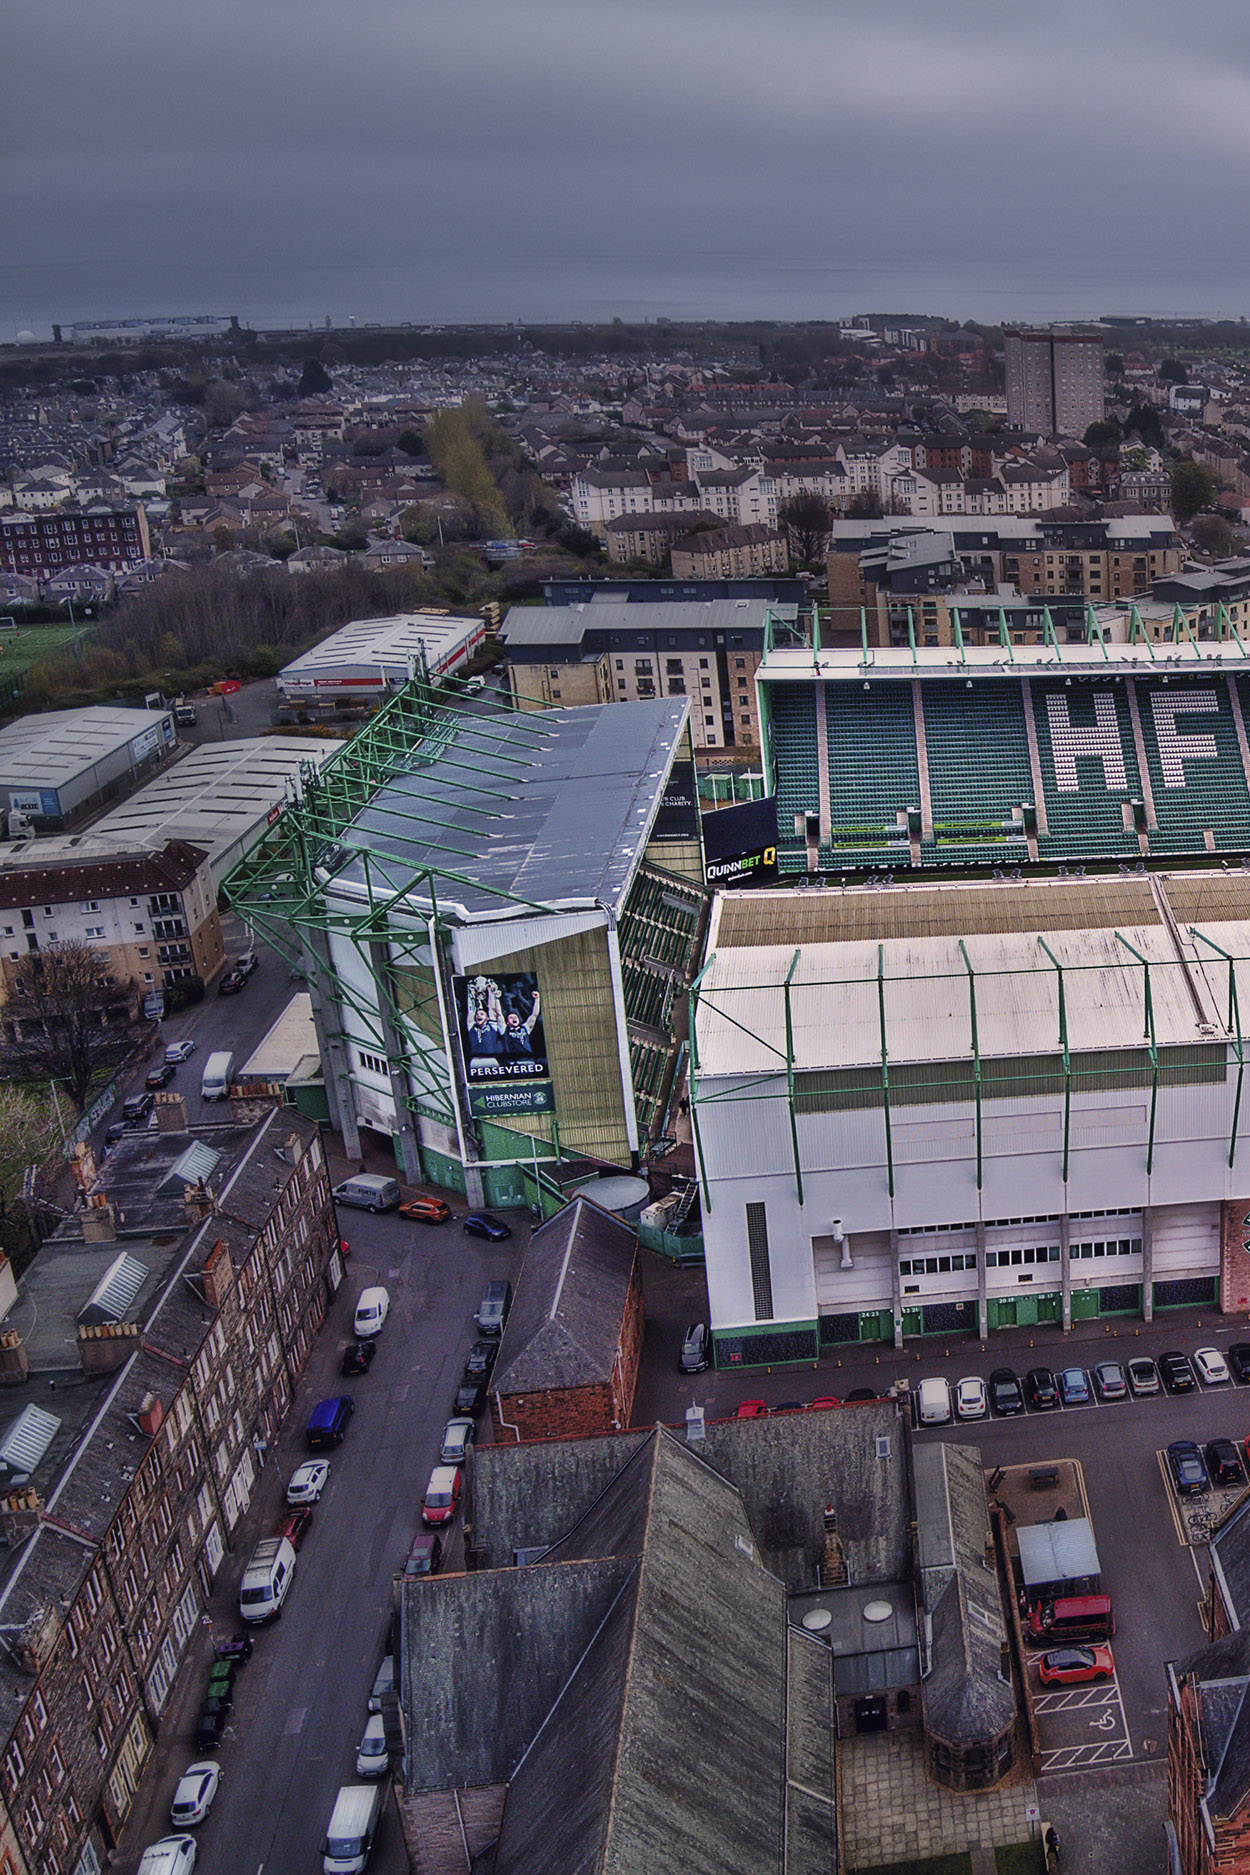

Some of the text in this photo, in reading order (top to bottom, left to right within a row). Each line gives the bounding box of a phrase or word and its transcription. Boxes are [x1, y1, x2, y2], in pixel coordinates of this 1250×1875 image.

[707, 854, 761, 880] QUINNBET
[470, 1063, 544, 1076] PERSEVERED
[485, 1092, 532, 1102] HIBERNIAN
[486, 1099, 532, 1109] CLUBSTORE
